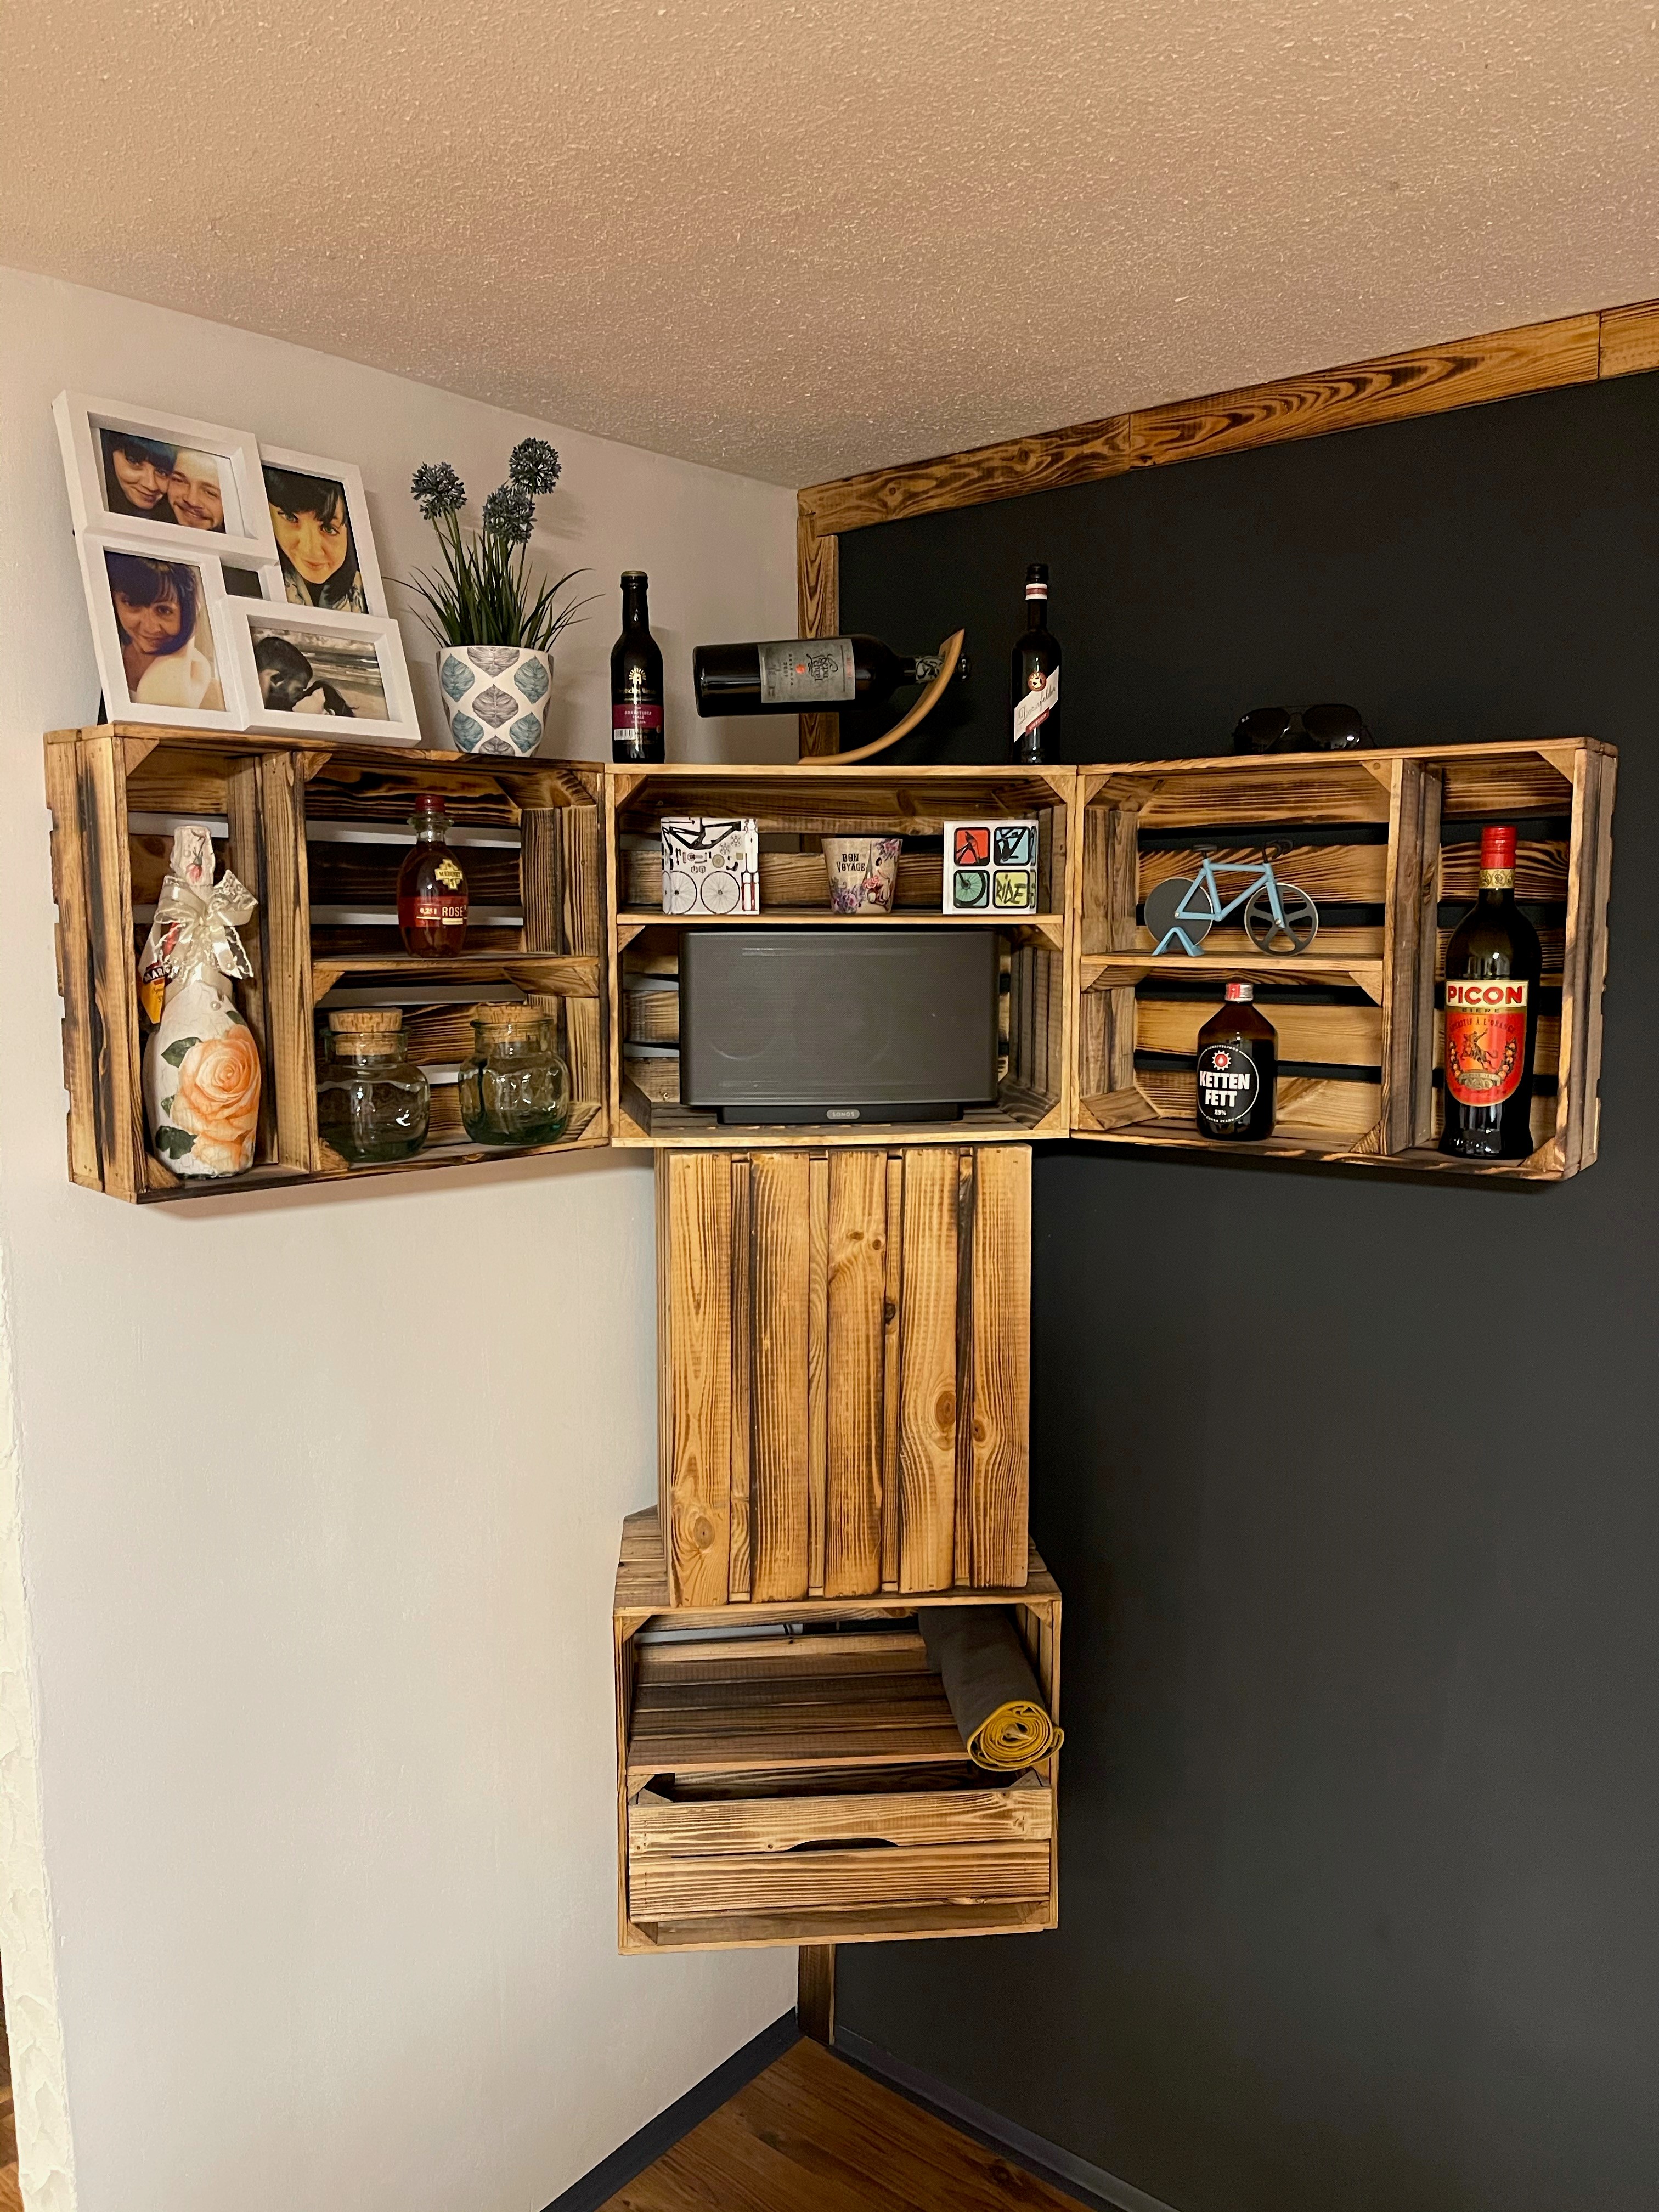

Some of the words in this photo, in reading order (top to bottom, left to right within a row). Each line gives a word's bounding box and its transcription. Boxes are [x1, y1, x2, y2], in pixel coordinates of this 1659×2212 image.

[842, 853, 860, 862] BON
[836, 861, 866, 873] VOYAGE
[1448, 985, 1523, 1005] PICON
[1199, 1070, 1250, 1090] KETTEN
[1205, 1089, 1238, 1107] FETT
